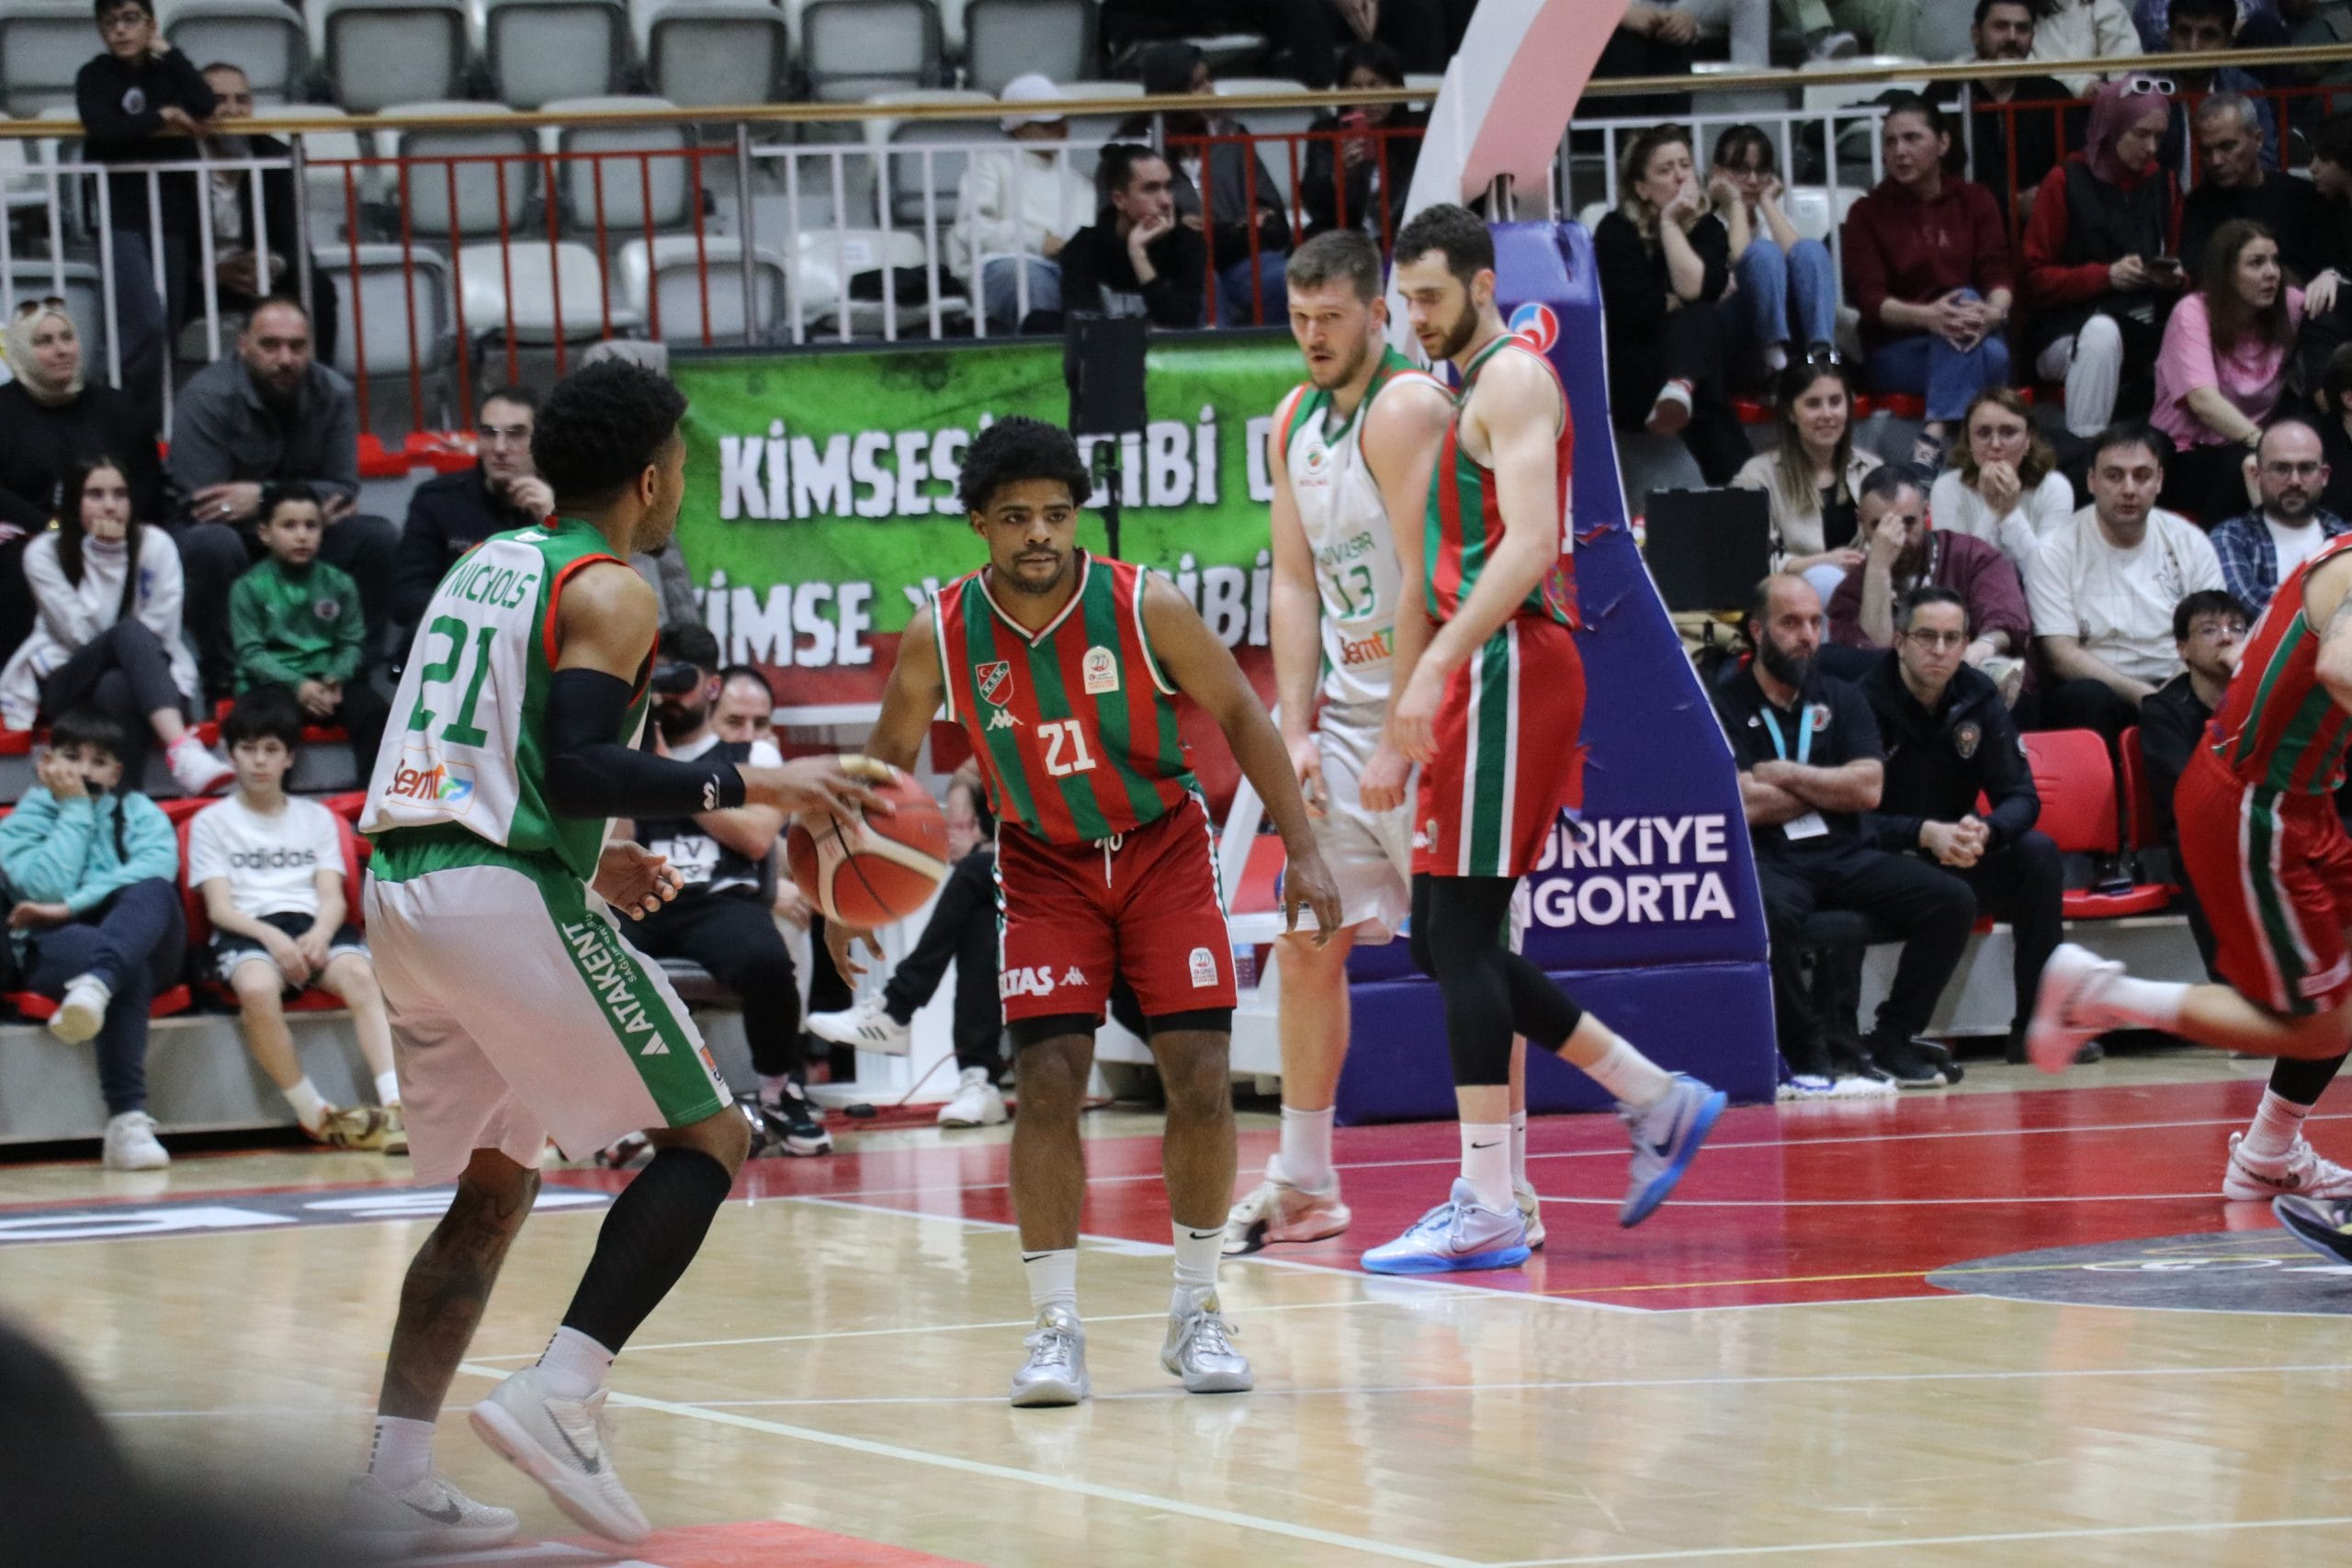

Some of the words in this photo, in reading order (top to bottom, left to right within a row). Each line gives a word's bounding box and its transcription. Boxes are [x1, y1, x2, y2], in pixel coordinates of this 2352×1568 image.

[719, 412, 994, 520] KİMSES
[446, 562, 538, 609] NICHOLS
[693, 568, 874, 671] İMSE
[1331, 564, 1376, 620] 13
[406, 615, 499, 749] 21
[1036, 719, 1097, 776] 21
[229, 847, 318, 870] adidas
[560, 921, 655, 1034] ATAKENT
